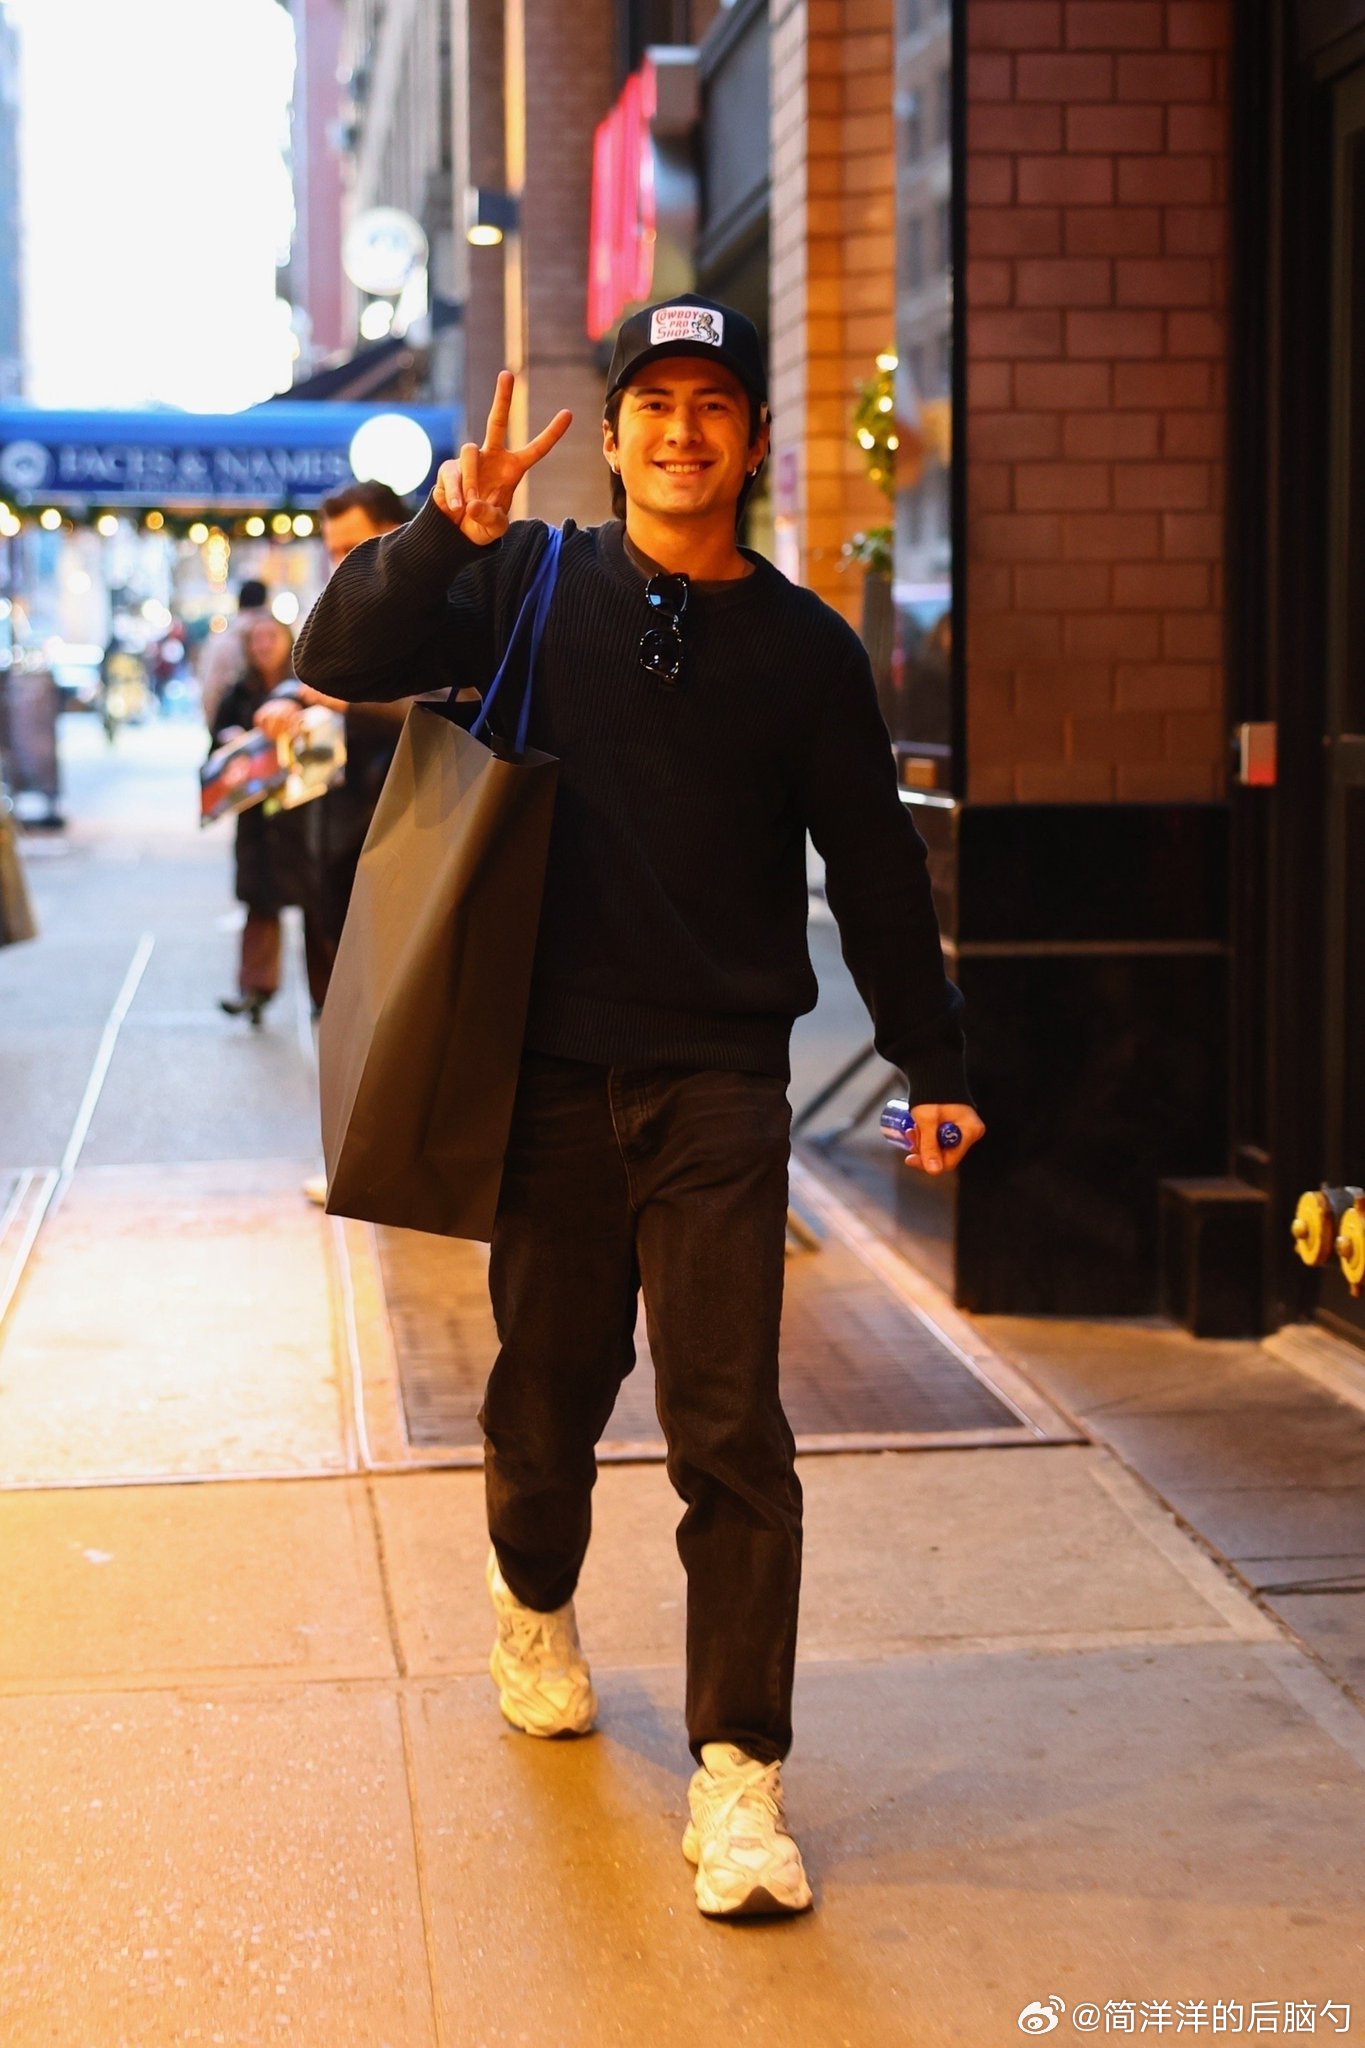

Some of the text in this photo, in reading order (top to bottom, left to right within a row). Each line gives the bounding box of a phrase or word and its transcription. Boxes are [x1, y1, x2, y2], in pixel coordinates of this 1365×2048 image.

[656, 309, 699, 325] COWBOY
[669, 320, 689, 328] PRO
[657, 327, 690, 339] SHOP
[59, 445, 173, 483] FACES
